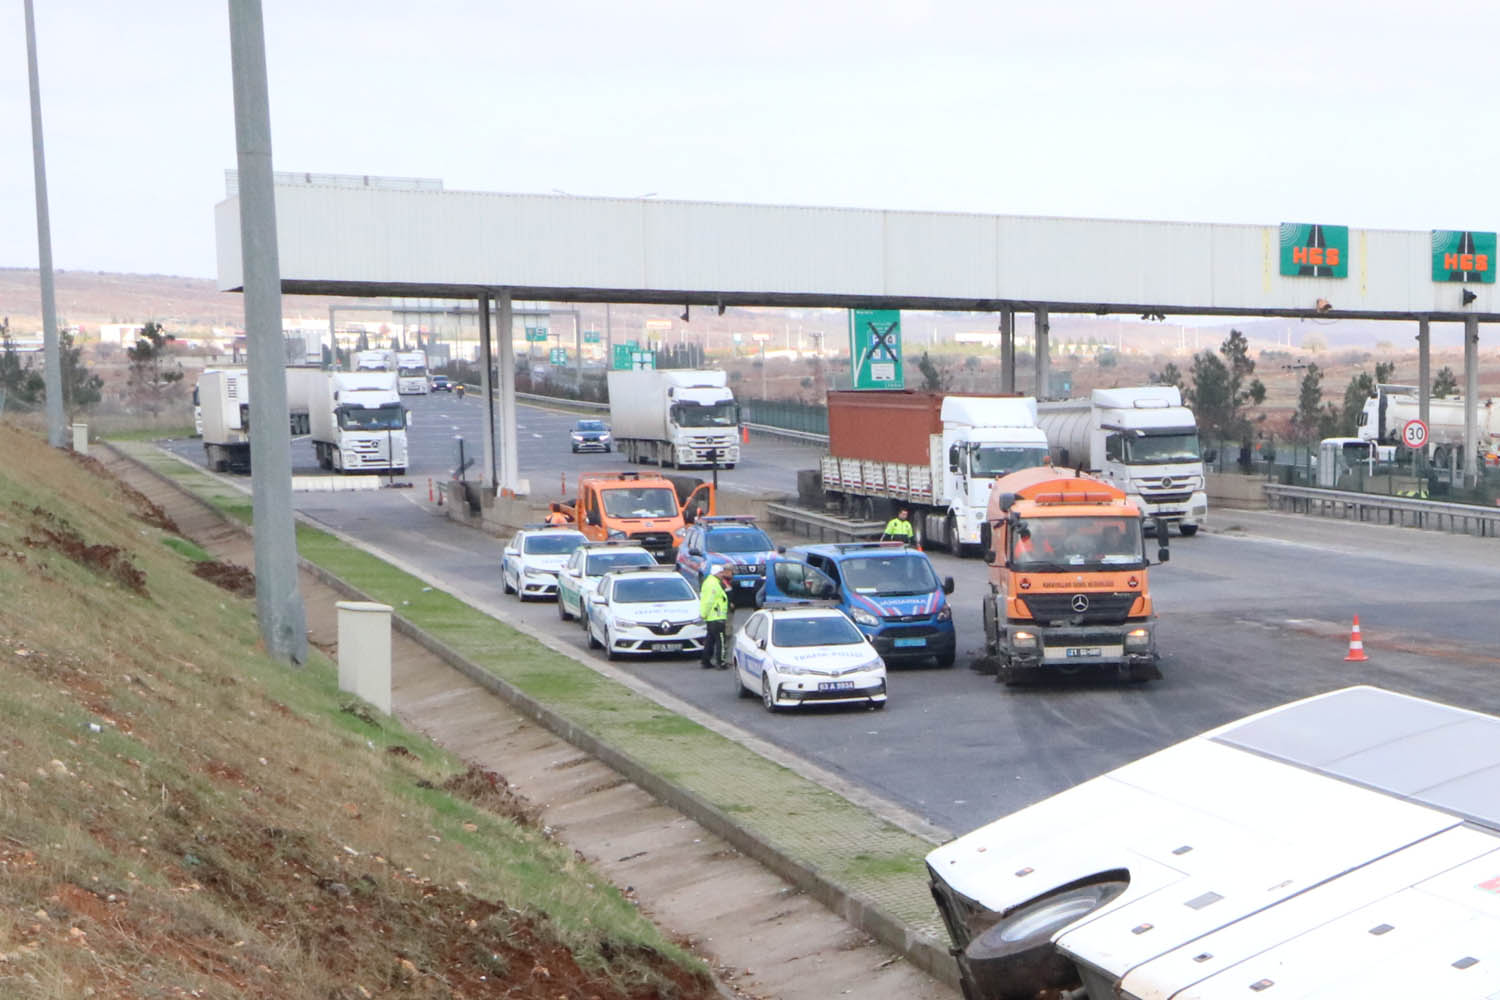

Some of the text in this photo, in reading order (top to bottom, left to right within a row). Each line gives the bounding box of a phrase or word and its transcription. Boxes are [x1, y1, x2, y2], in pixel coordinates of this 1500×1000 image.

[1292, 246, 1340, 266] HGS
[1444, 252, 1489, 271] HGS
[1408, 426, 1424, 440] 30
